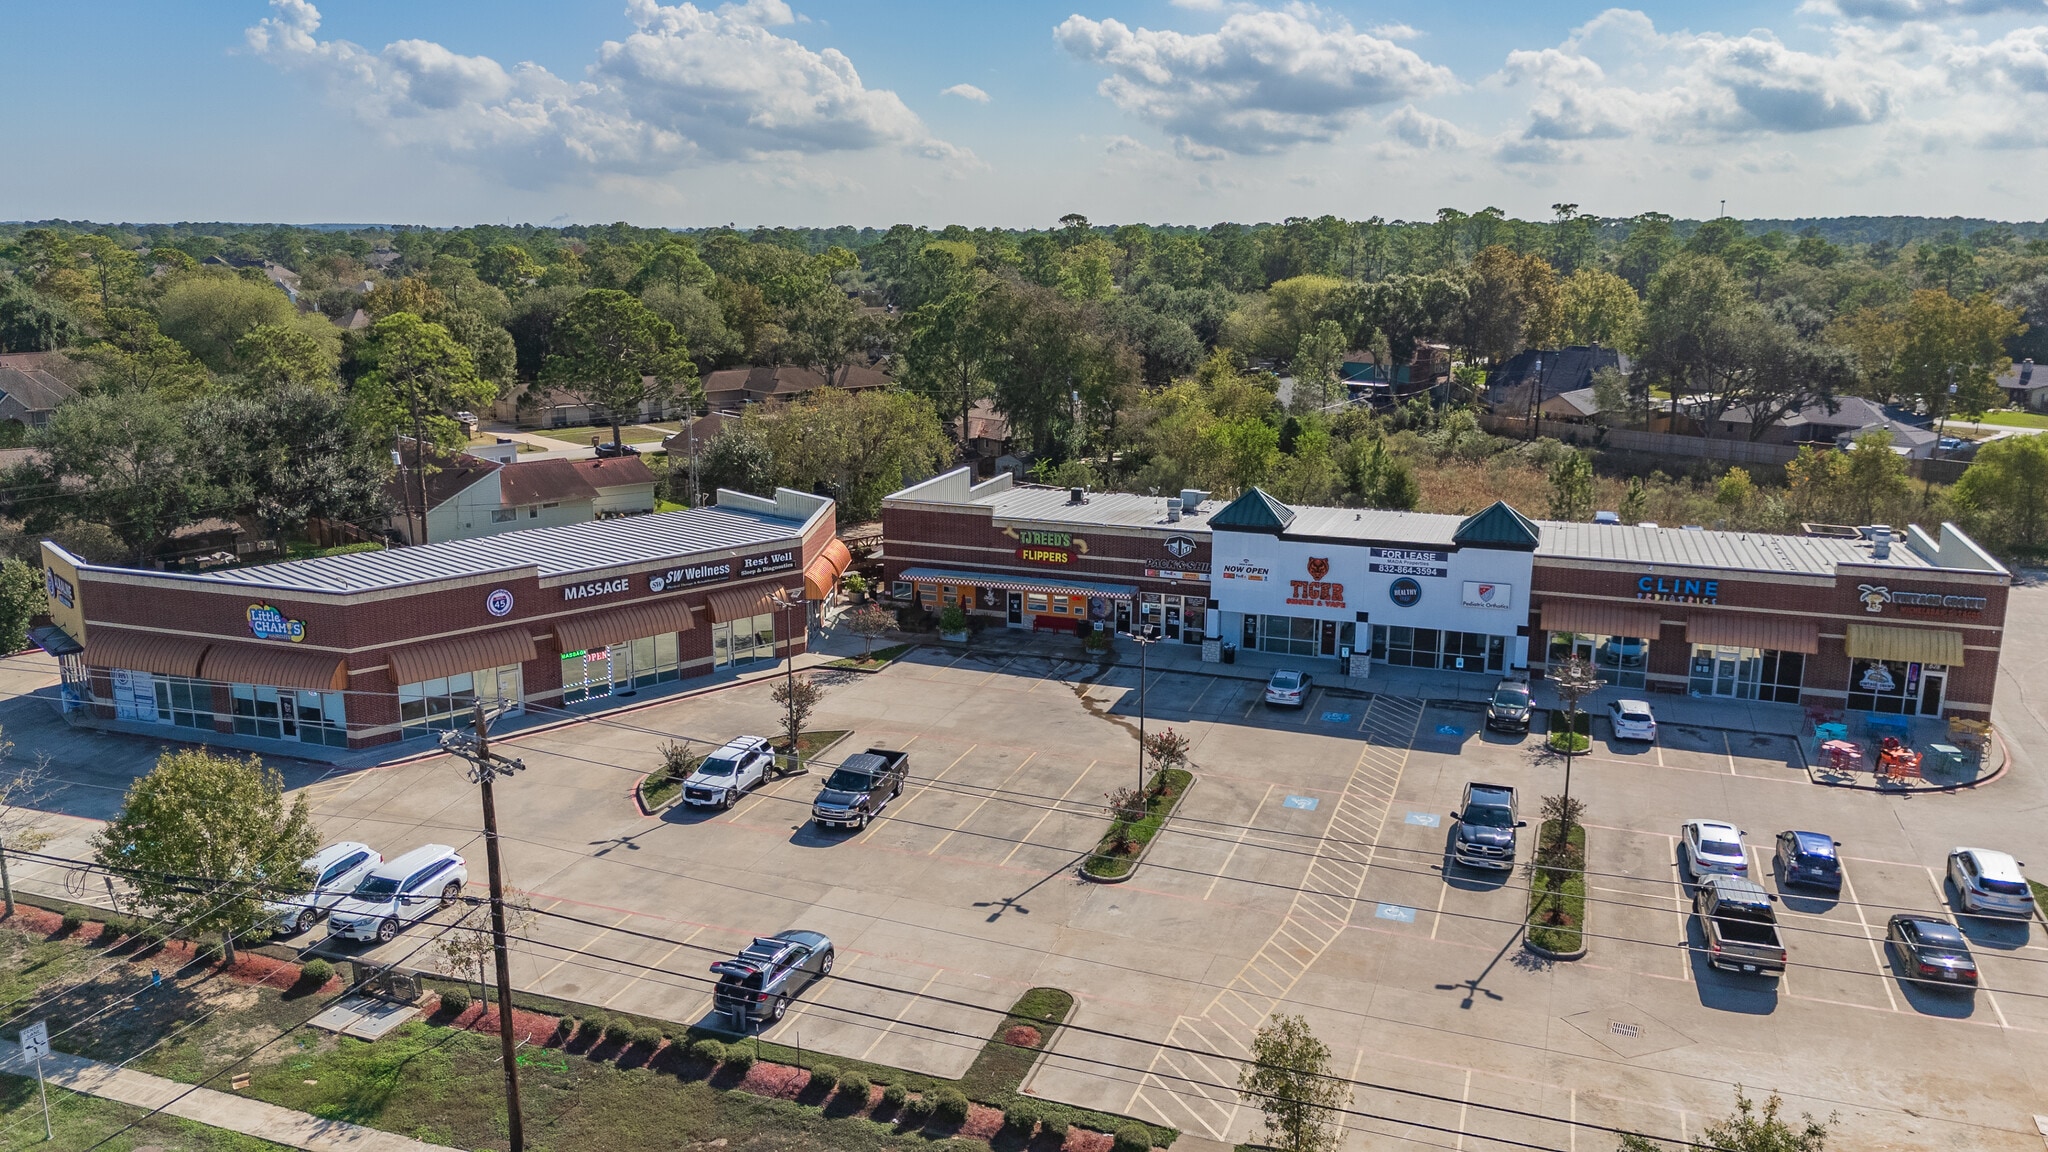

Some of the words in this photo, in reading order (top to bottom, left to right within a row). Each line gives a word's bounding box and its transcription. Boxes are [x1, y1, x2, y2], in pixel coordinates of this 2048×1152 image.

[1034, 532, 1071, 547] REED'S
[744, 556, 769, 568] Rest
[771, 551, 793, 563] Well
[1023, 549, 1068, 563] FLIPPERS
[1381, 550, 1402, 559] FOR
[1404, 551, 1436, 561] LEASE
[1145, 558, 1176, 569] PACK
[1224, 565, 1245, 573] NOW
[1246, 566, 1269, 575] OPEN
[1378, 564, 1437, 576] 832-864-3594
[665, 570, 685, 584] SW
[685, 564, 730, 580] Wellness
[564, 578, 630, 601] MASSAGE
[1290, 580, 1343, 601] TIGER
[1394, 588, 1417, 596] HEALTHY
[1638, 576, 1719, 597] CLINE
[494, 600, 507, 608] 45
[1637, 592, 1717, 605] PEDIATRICS
[251, 610, 281, 622] Little
